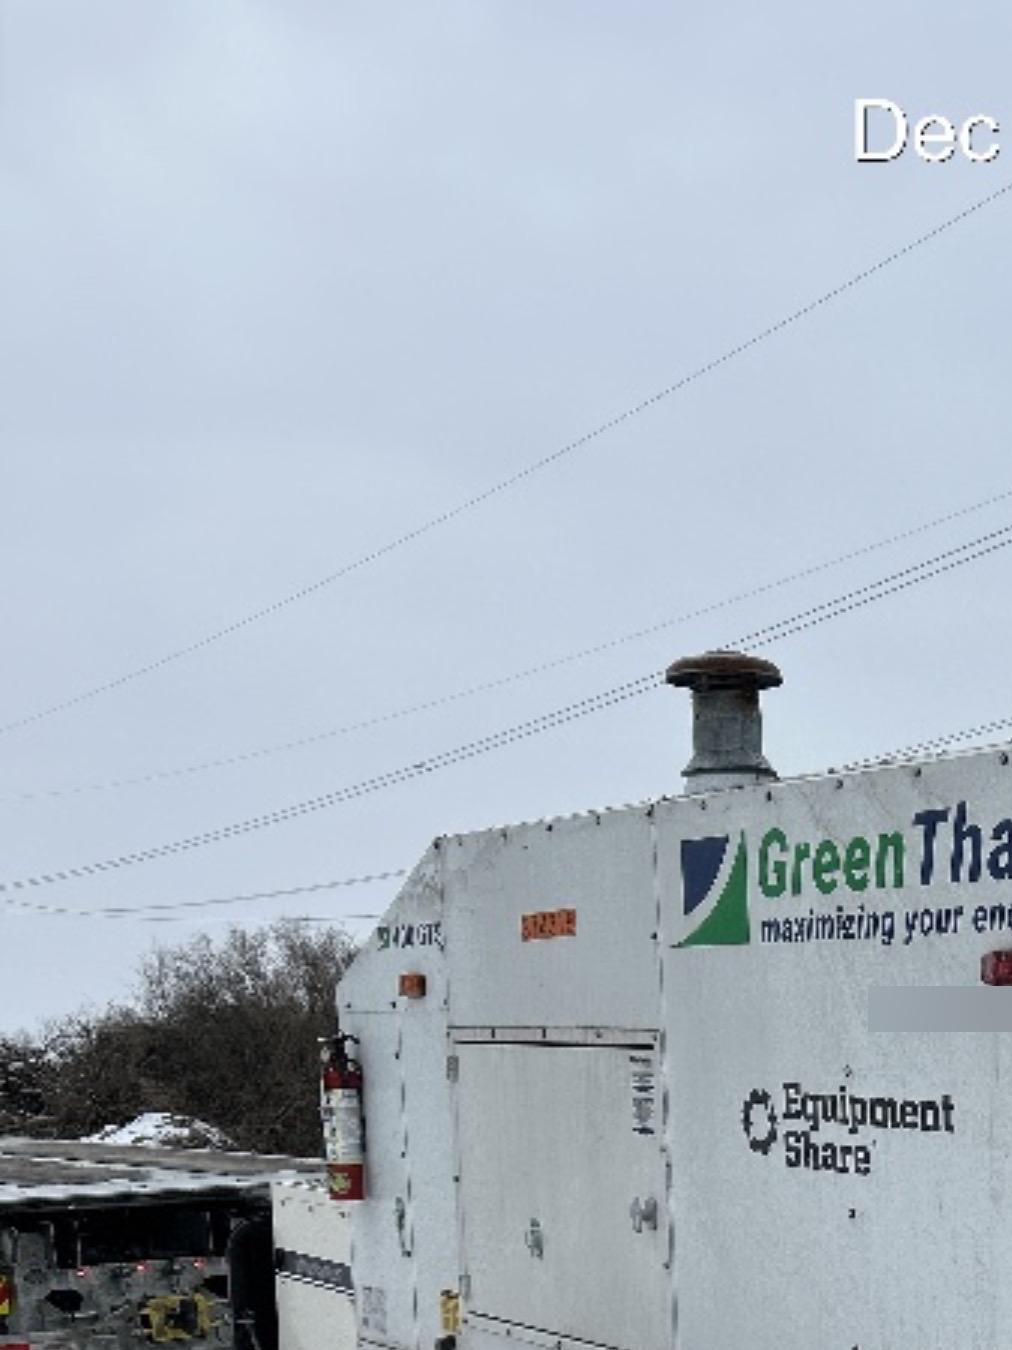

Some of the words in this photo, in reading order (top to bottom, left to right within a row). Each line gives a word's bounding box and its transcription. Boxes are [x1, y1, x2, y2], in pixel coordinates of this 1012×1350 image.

[761, 902, 896, 946] maximizing
[903, 906, 964, 945] your
[783, 1082, 955, 1135] Equipment
[784, 1130, 871, 1176] Share
